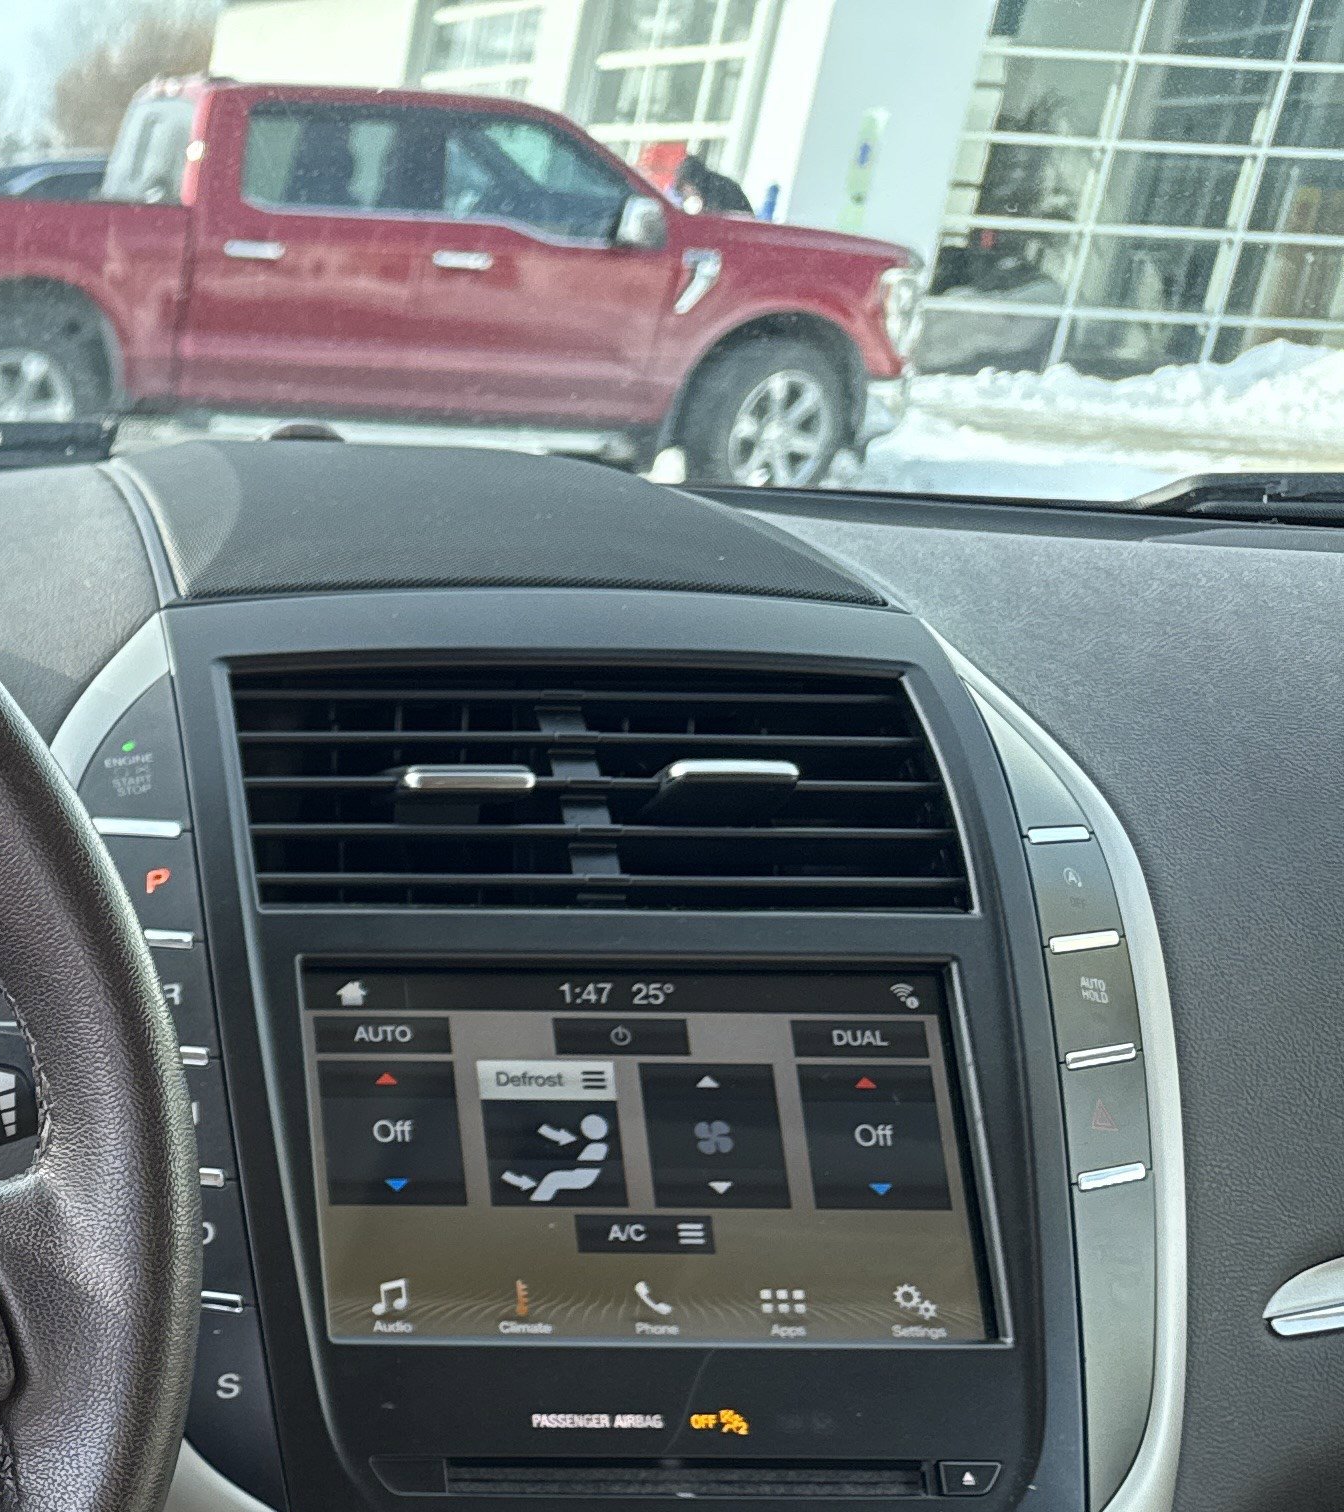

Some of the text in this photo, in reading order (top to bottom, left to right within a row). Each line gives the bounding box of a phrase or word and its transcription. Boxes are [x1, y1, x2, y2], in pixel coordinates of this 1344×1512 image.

[104, 752, 154, 768] ENGINE
[145, 868, 170, 893] P
[1080, 976, 1106, 991] AUTO
[558, 982, 676, 1005] 1:47 25°
[1081, 989, 1109, 1004] HOLD
[353, 1024, 412, 1044] AUTO
[832, 1028, 889, 1048] DUAL
[495, 1069, 564, 1088] Defrost
[373, 1119, 412, 1144] Off
[854, 1123, 893, 1148] Off
[607, 1221, 647, 1243] A/C
[372, 1319, 413, 1335] Audio
[499, 1320, 553, 1336] Climate
[635, 1321, 679, 1337] Phone
[771, 1322, 807, 1340] Apps
[892, 1323, 948, 1341] Settings
[216, 1373, 241, 1398] S
[531, 1413, 717, 1429] PASSENGER AIRBAG OFF
